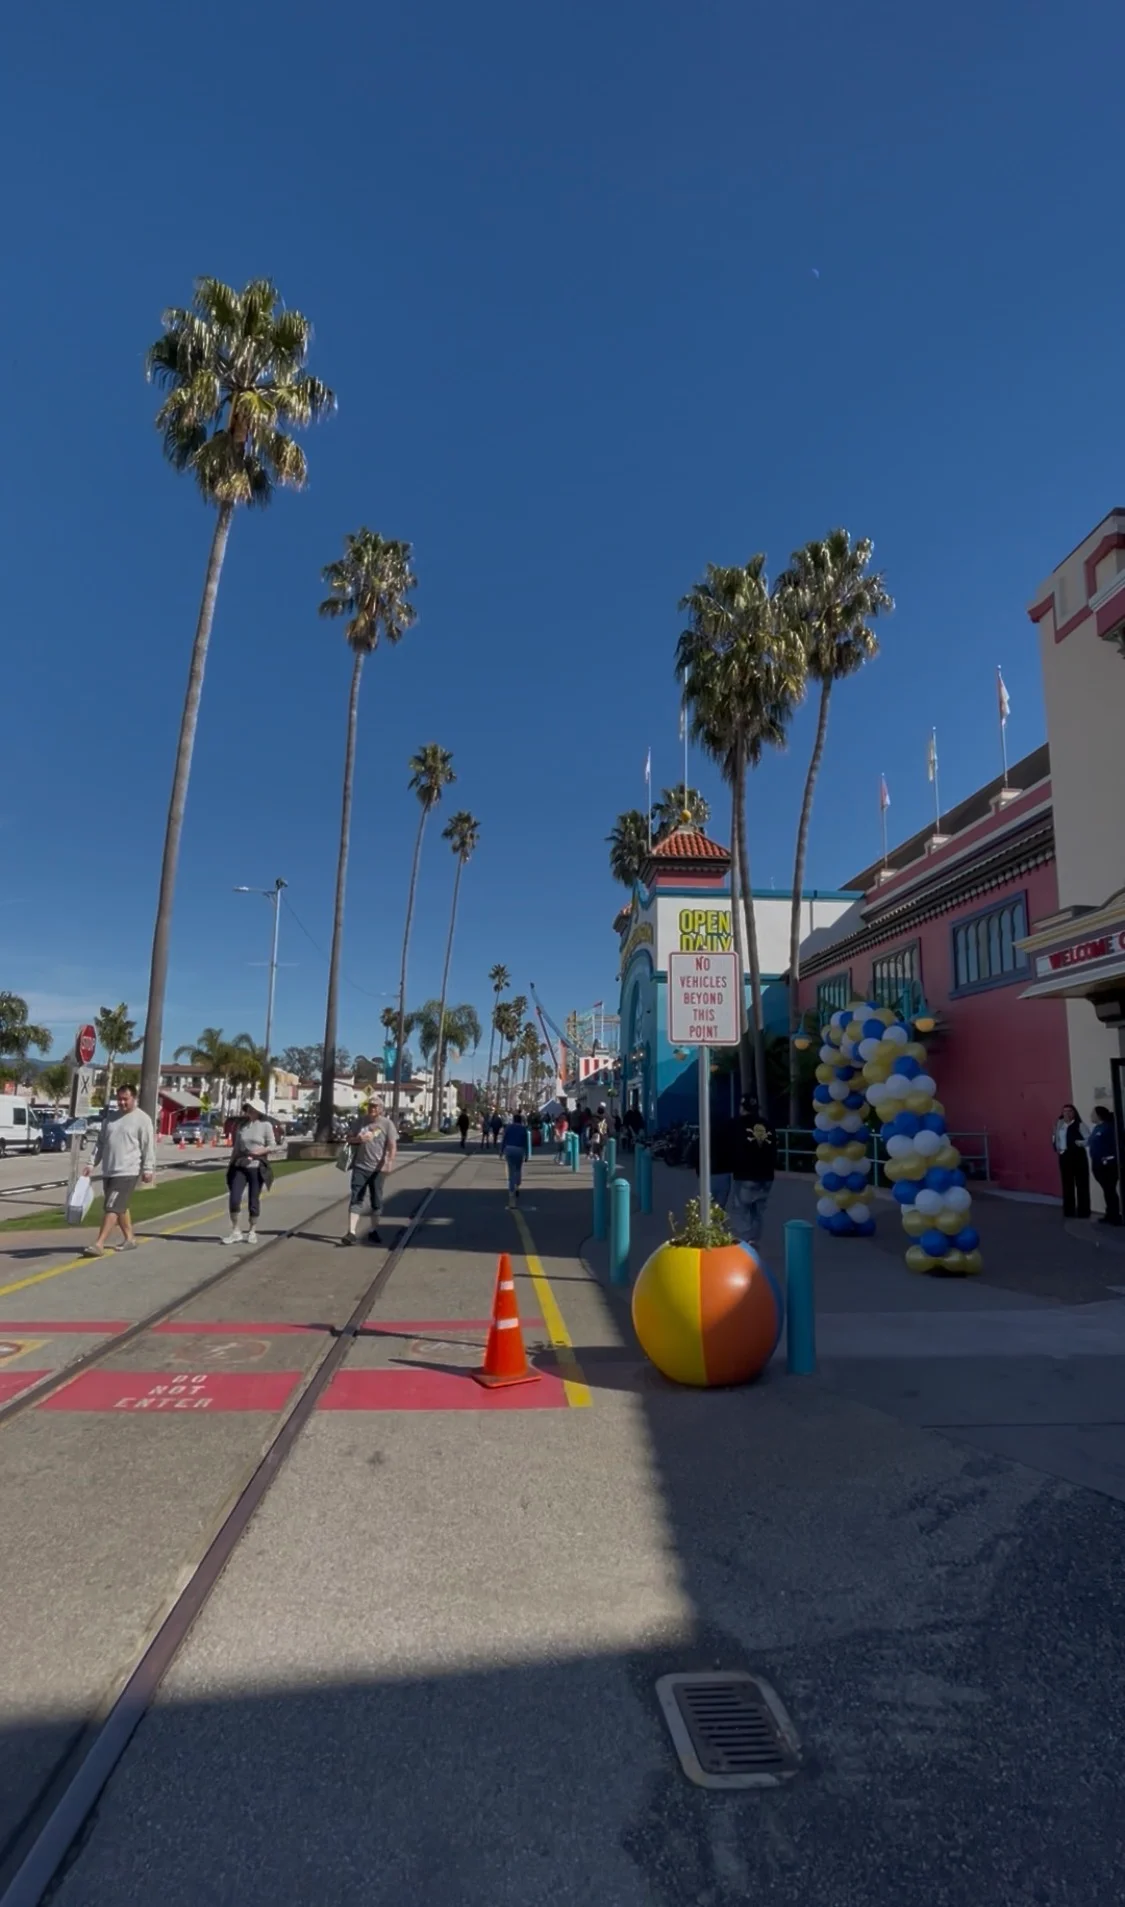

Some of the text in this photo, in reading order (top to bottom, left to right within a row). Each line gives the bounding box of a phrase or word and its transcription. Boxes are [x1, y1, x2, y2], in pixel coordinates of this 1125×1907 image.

[679, 909, 731, 934] OPEN
[1049, 936, 1115, 970] WELCOME
[695, 957, 711, 971] NO
[679, 975, 728, 988] VEHICLES
[683, 992, 724, 1005] BEYOND
[692, 1008, 716, 1021] THIS
[689, 1025, 719, 1038] POINT
[81, 1036, 95, 1051] STOP
[172, 1374, 208, 1383] DO
[148, 1385, 206, 1395] NOT
[113, 1397, 213, 1408] ENTER
